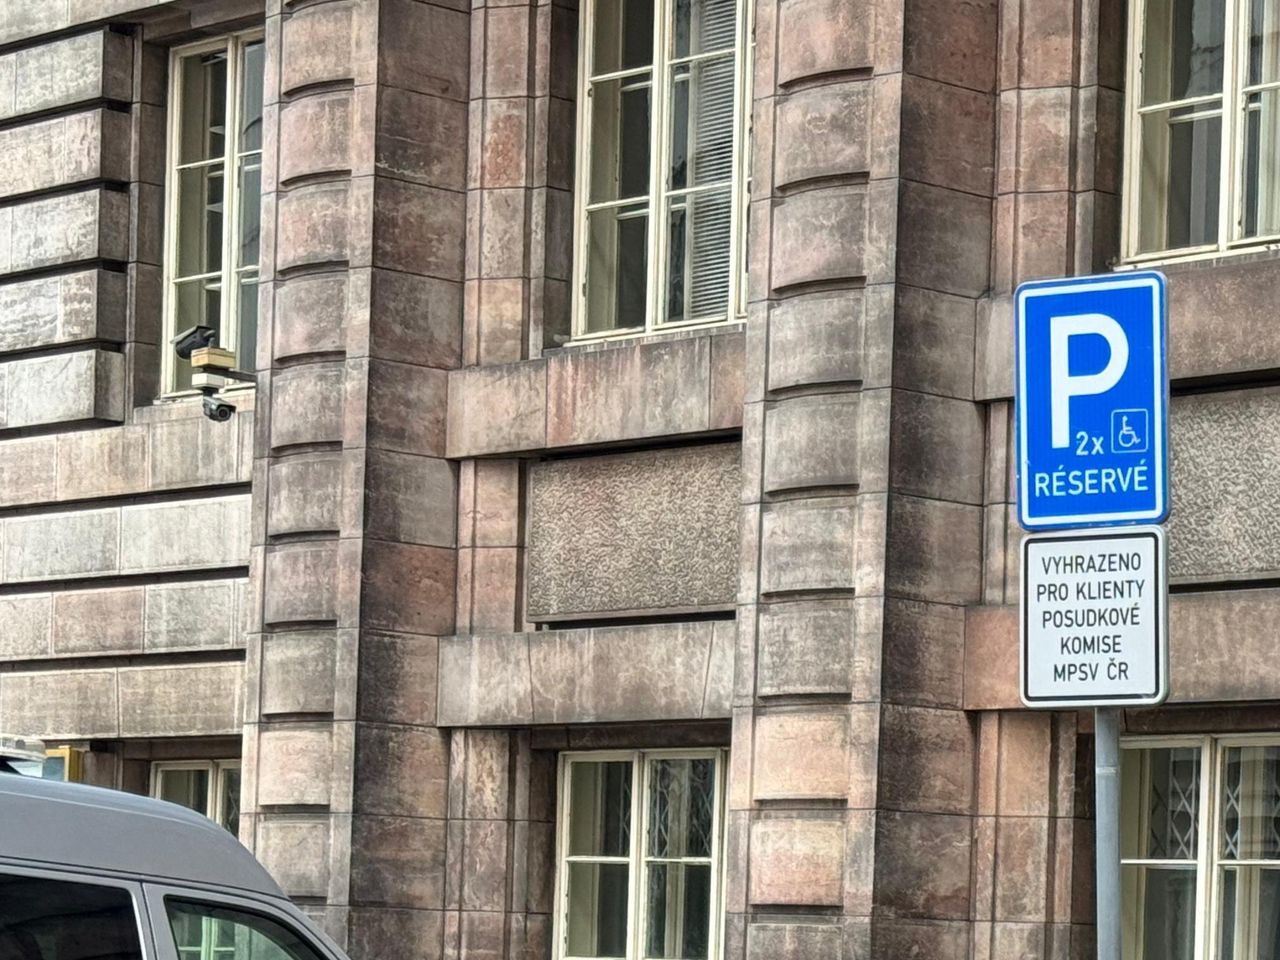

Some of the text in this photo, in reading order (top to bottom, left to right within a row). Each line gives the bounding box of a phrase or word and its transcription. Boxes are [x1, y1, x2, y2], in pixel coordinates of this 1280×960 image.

[1049, 313, 1129, 449] P
[1075, 430, 1105, 456] 2x
[1034, 459, 1149, 497] RÉSERVÉ
[1040, 551, 1142, 575] VYHRAZENO
[1036, 578, 1145, 602] PRO KLIENTY
[1041, 602, 1141, 629] POSUDKOVÉ
[1060, 634, 1122, 656] KOMISE
[1053, 656, 1129, 683] MPSV ČR
